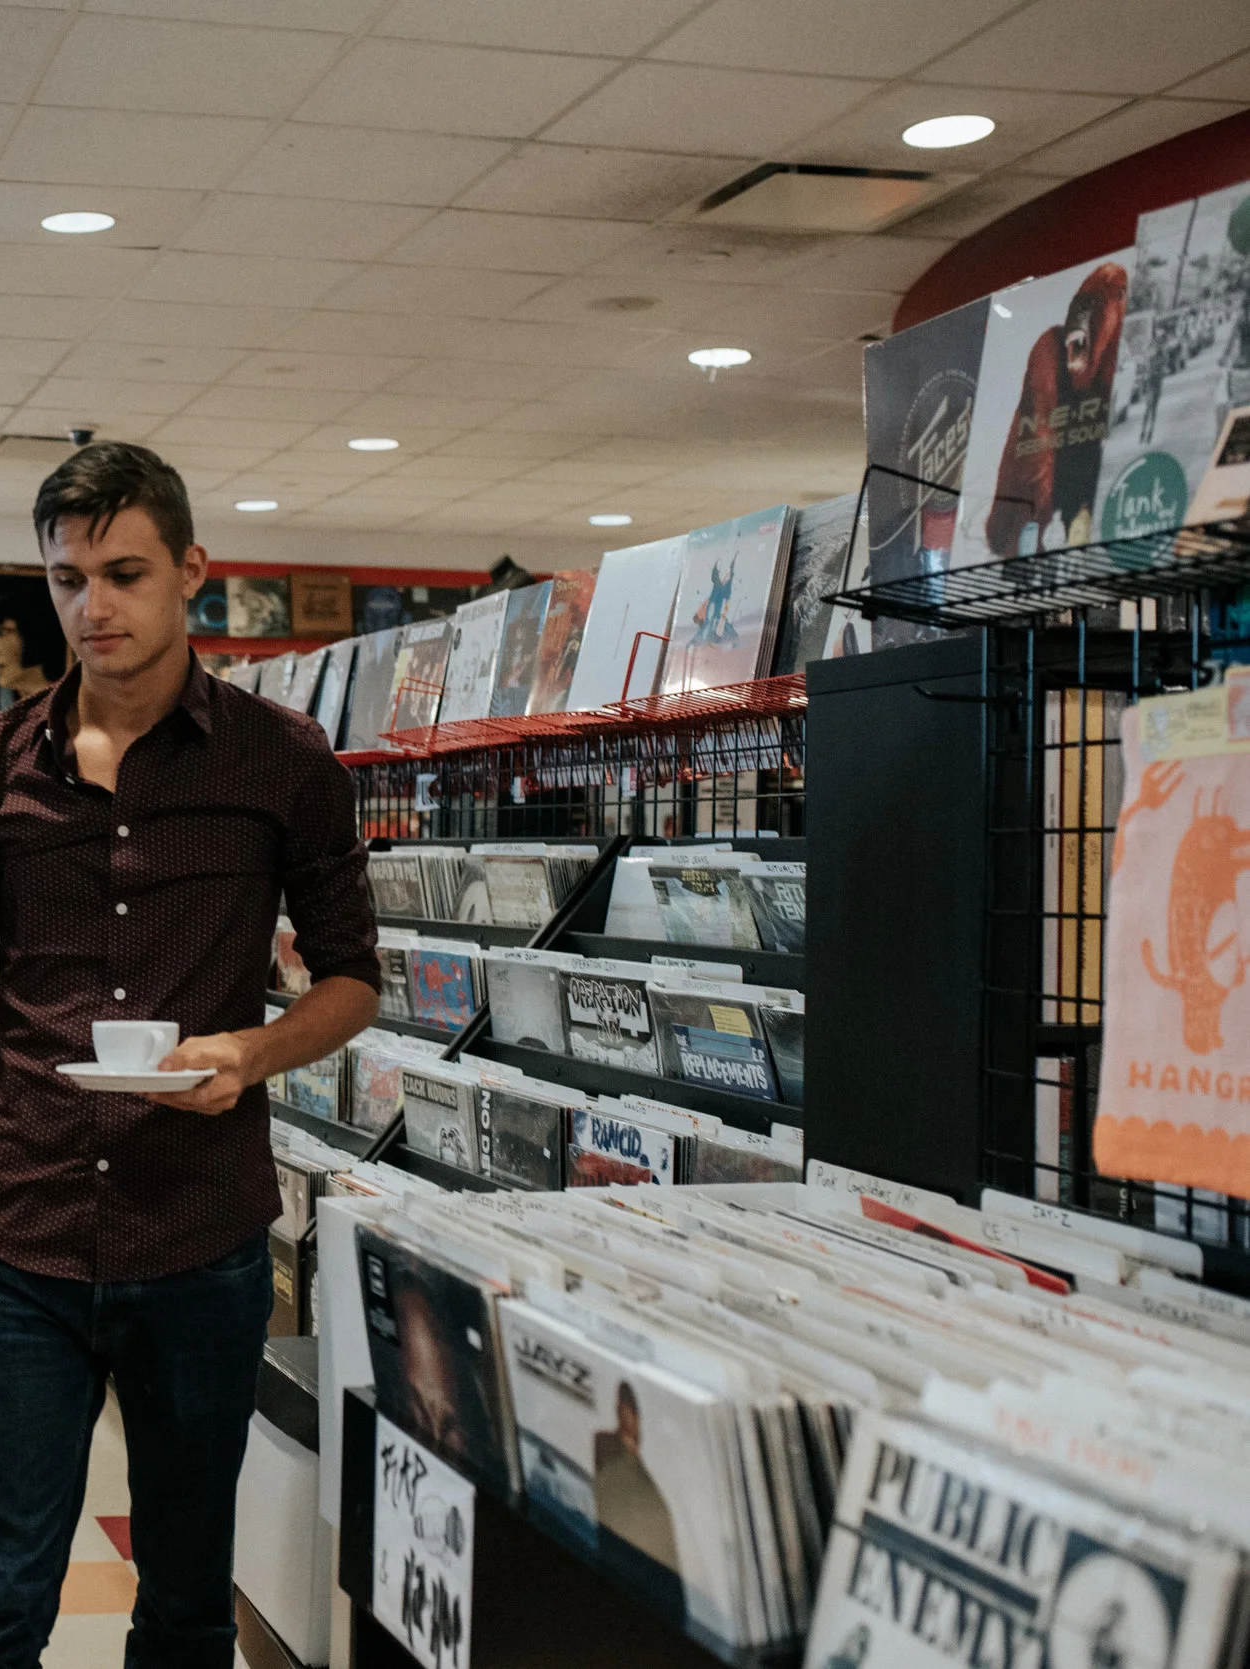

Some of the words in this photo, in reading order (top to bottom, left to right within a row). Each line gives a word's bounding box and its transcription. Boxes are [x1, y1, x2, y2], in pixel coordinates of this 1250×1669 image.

[766, 864, 793, 875] RITUAL
[569, 977, 642, 1018] OPERATION
[403, 1074, 425, 1098] ZACK
[680, 1052, 769, 1091] REPLACEMENTS
[481, 1090, 491, 1130] NO
[591, 1116, 643, 1160] RANCID
[867, 1440, 1060, 1578] PUBLIC
